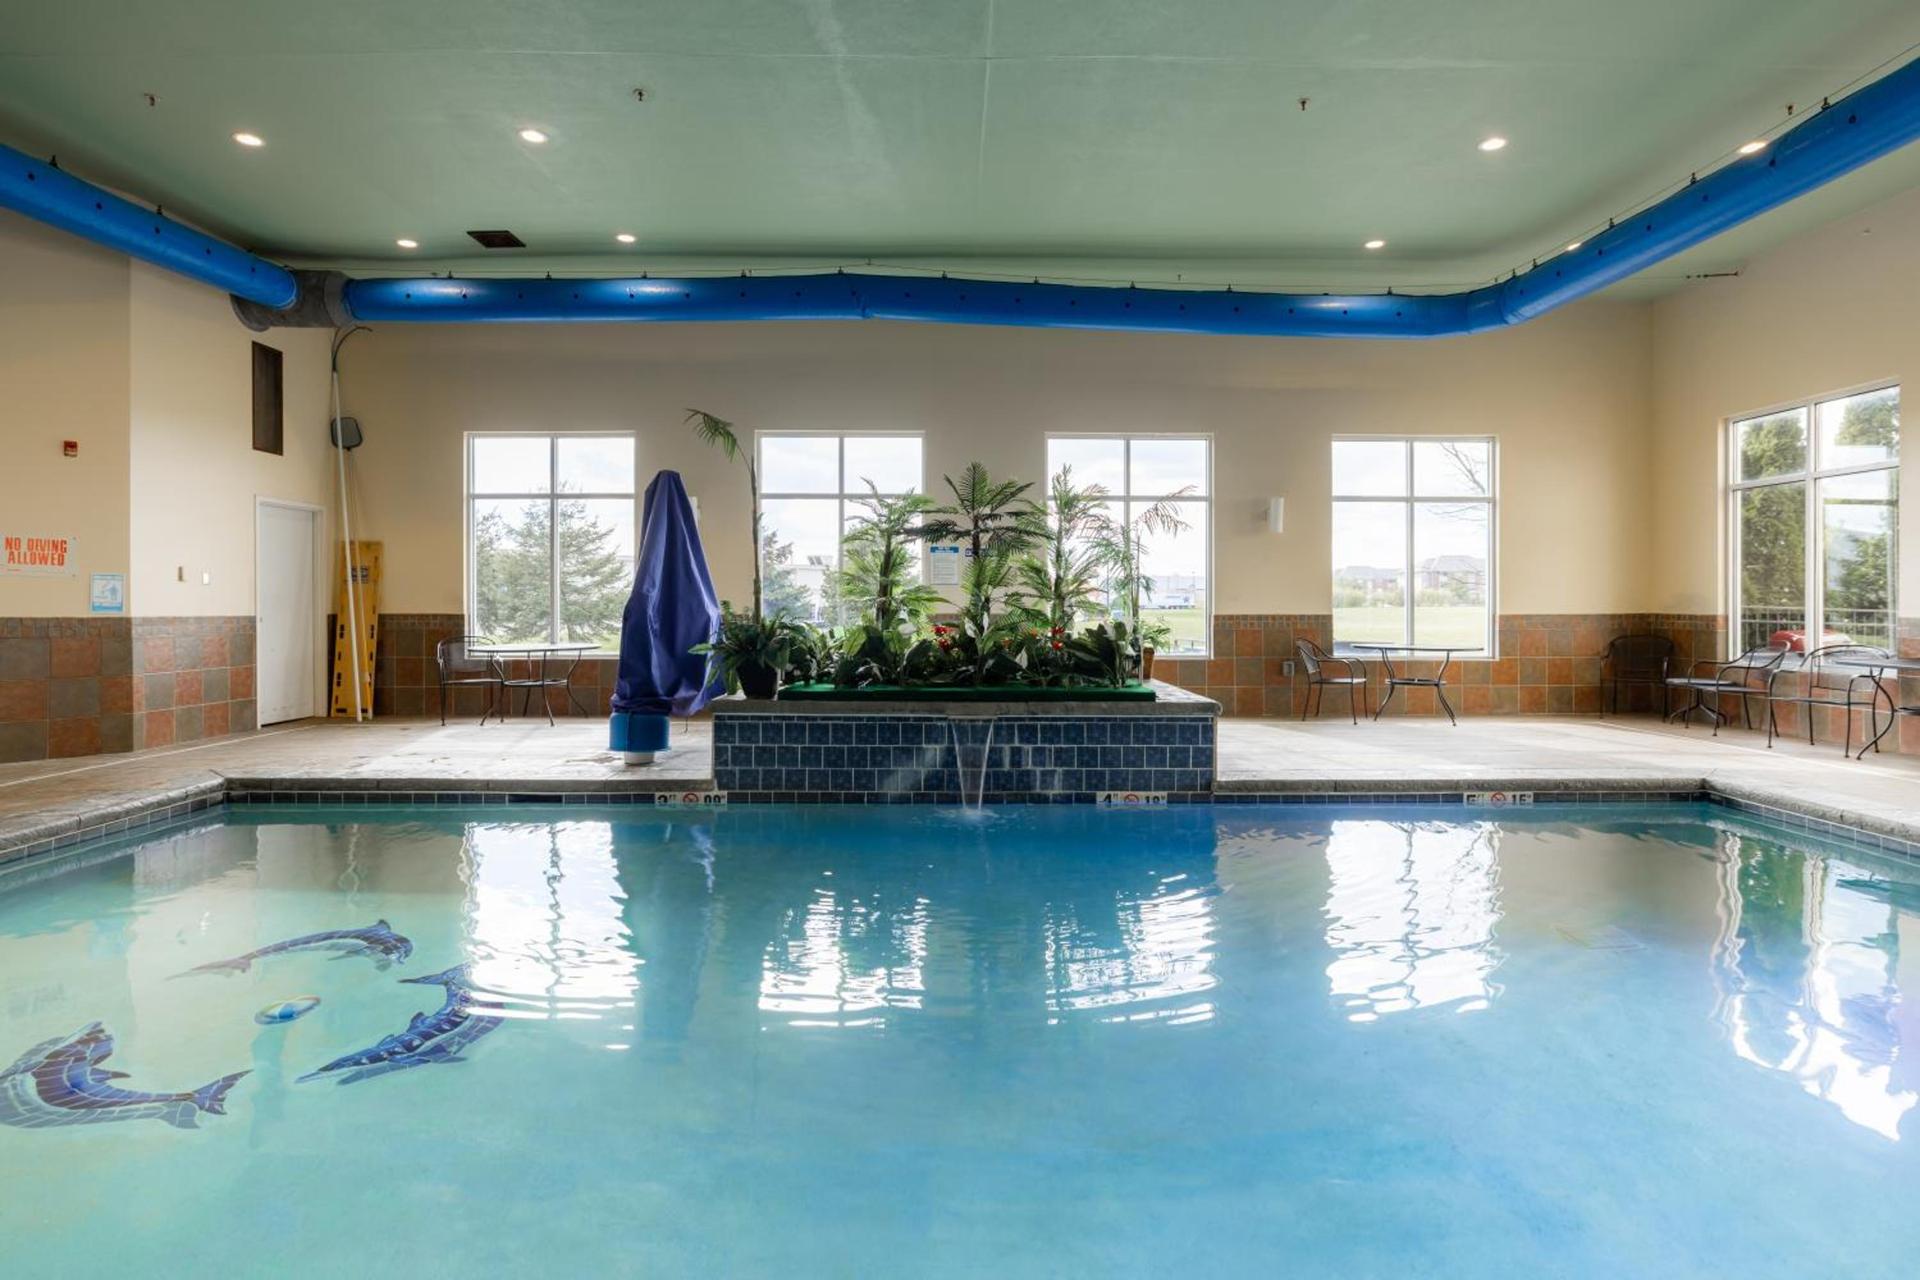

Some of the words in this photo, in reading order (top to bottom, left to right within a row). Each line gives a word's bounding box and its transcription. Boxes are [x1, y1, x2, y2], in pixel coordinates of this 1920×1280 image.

[5, 536, 21, 551] NO
[27, 537, 68, 553] DIVING
[7, 551, 65, 566] ALLOWED
